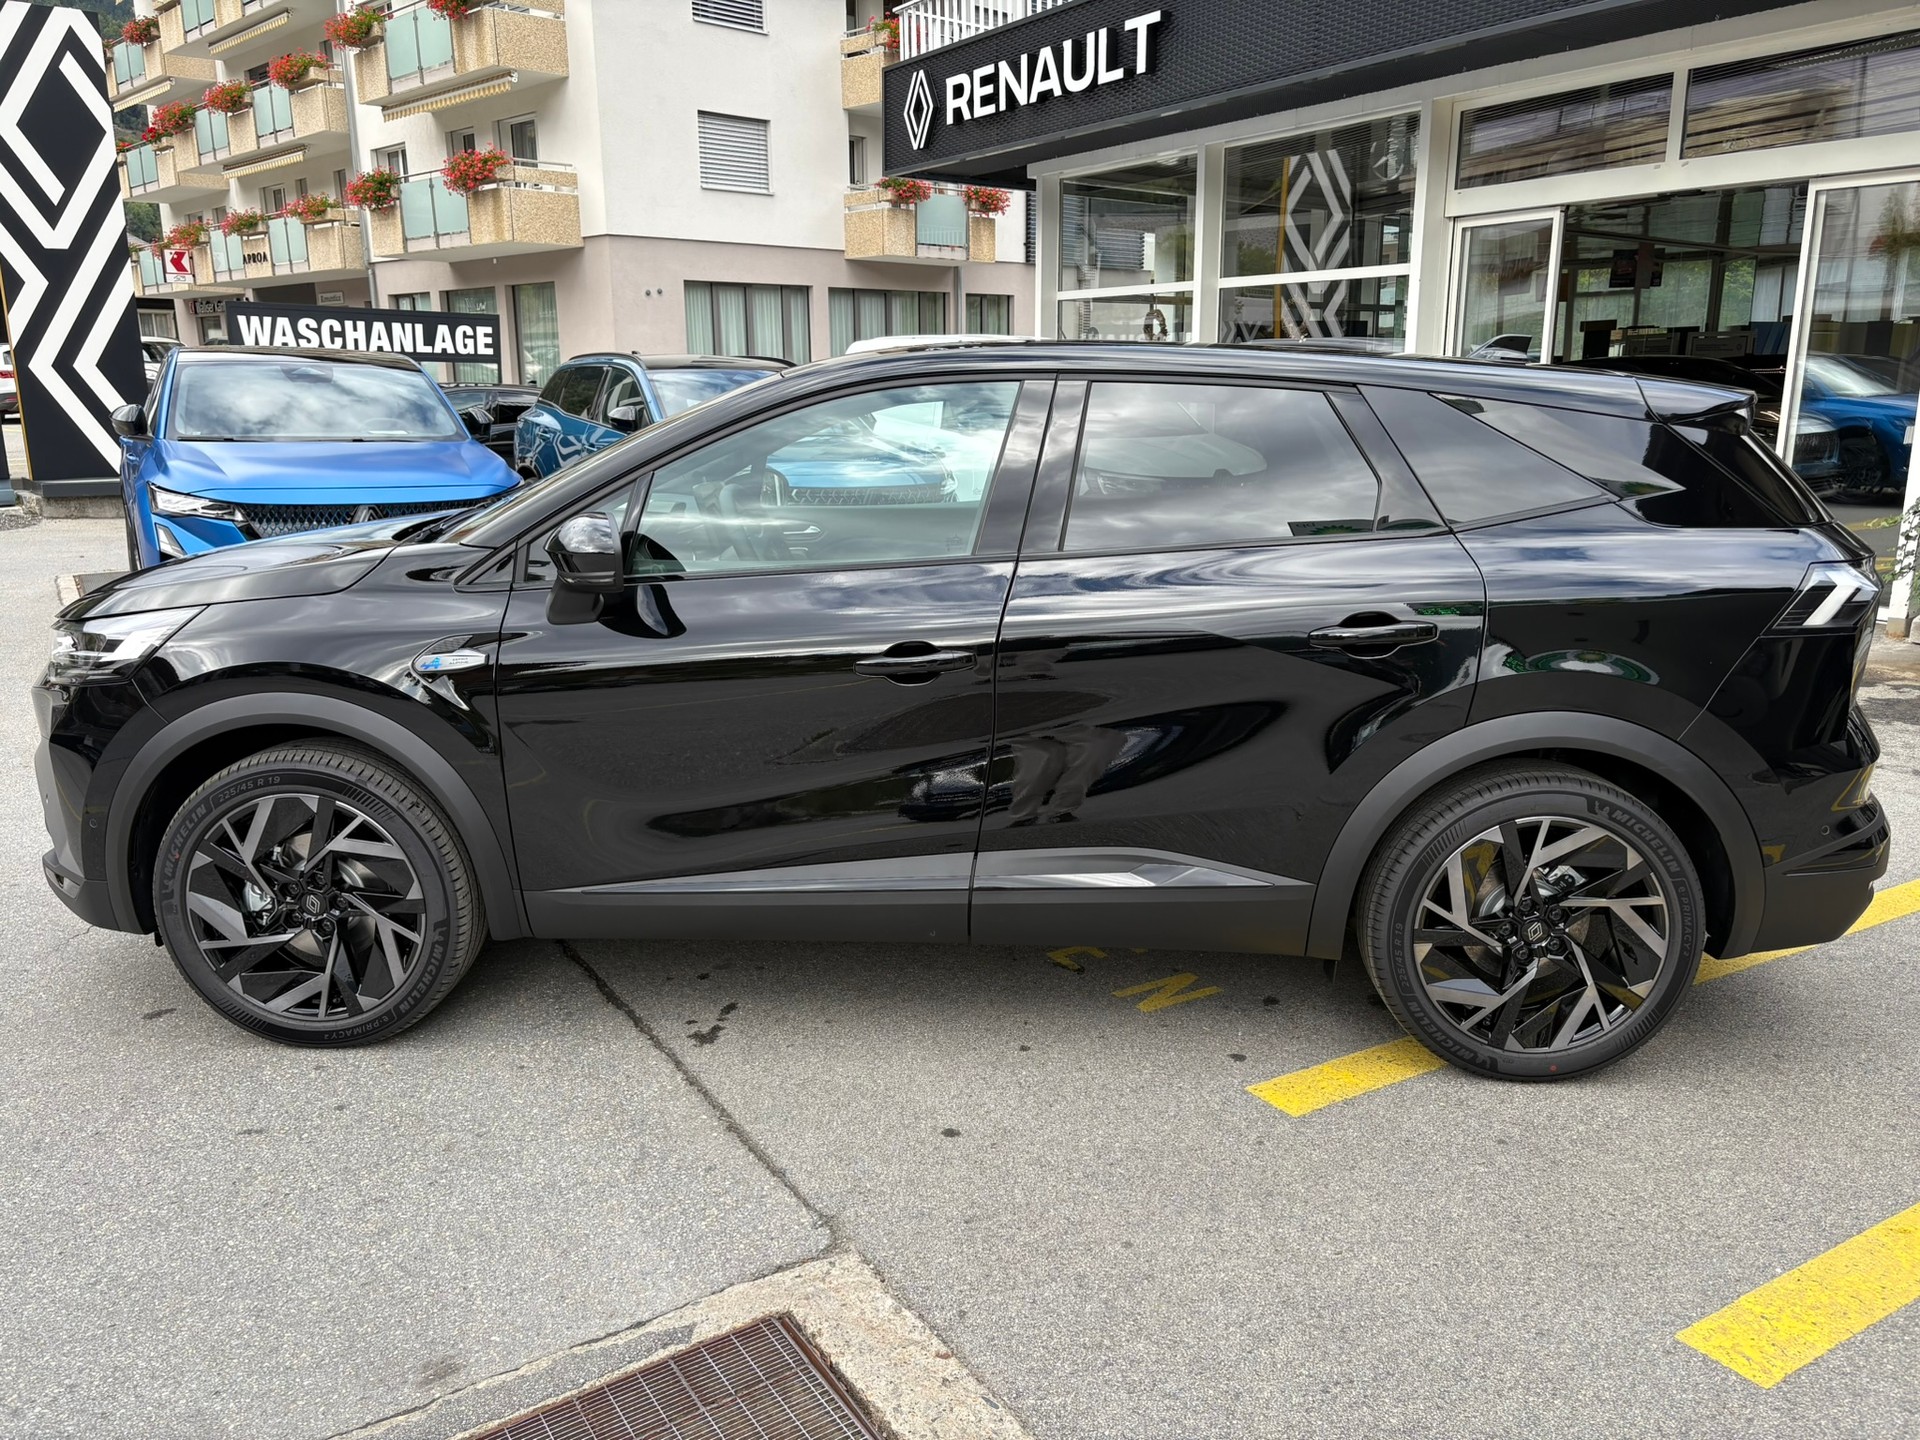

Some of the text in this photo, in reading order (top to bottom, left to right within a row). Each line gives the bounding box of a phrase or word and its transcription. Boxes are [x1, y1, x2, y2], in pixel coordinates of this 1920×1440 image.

[945, 10, 1161, 125] RENAULT
[237, 315, 494, 355] WASCHANLAGE
[218, 780, 254, 802] 225/45
[268, 776, 280, 784] 19
[164, 804, 207, 878] MICHELIN
[1612, 810, 1681, 873] MICHELIN
[399, 944, 443, 1013] MICHELIN
[1407, 1001, 1475, 1060] MICHELIN
